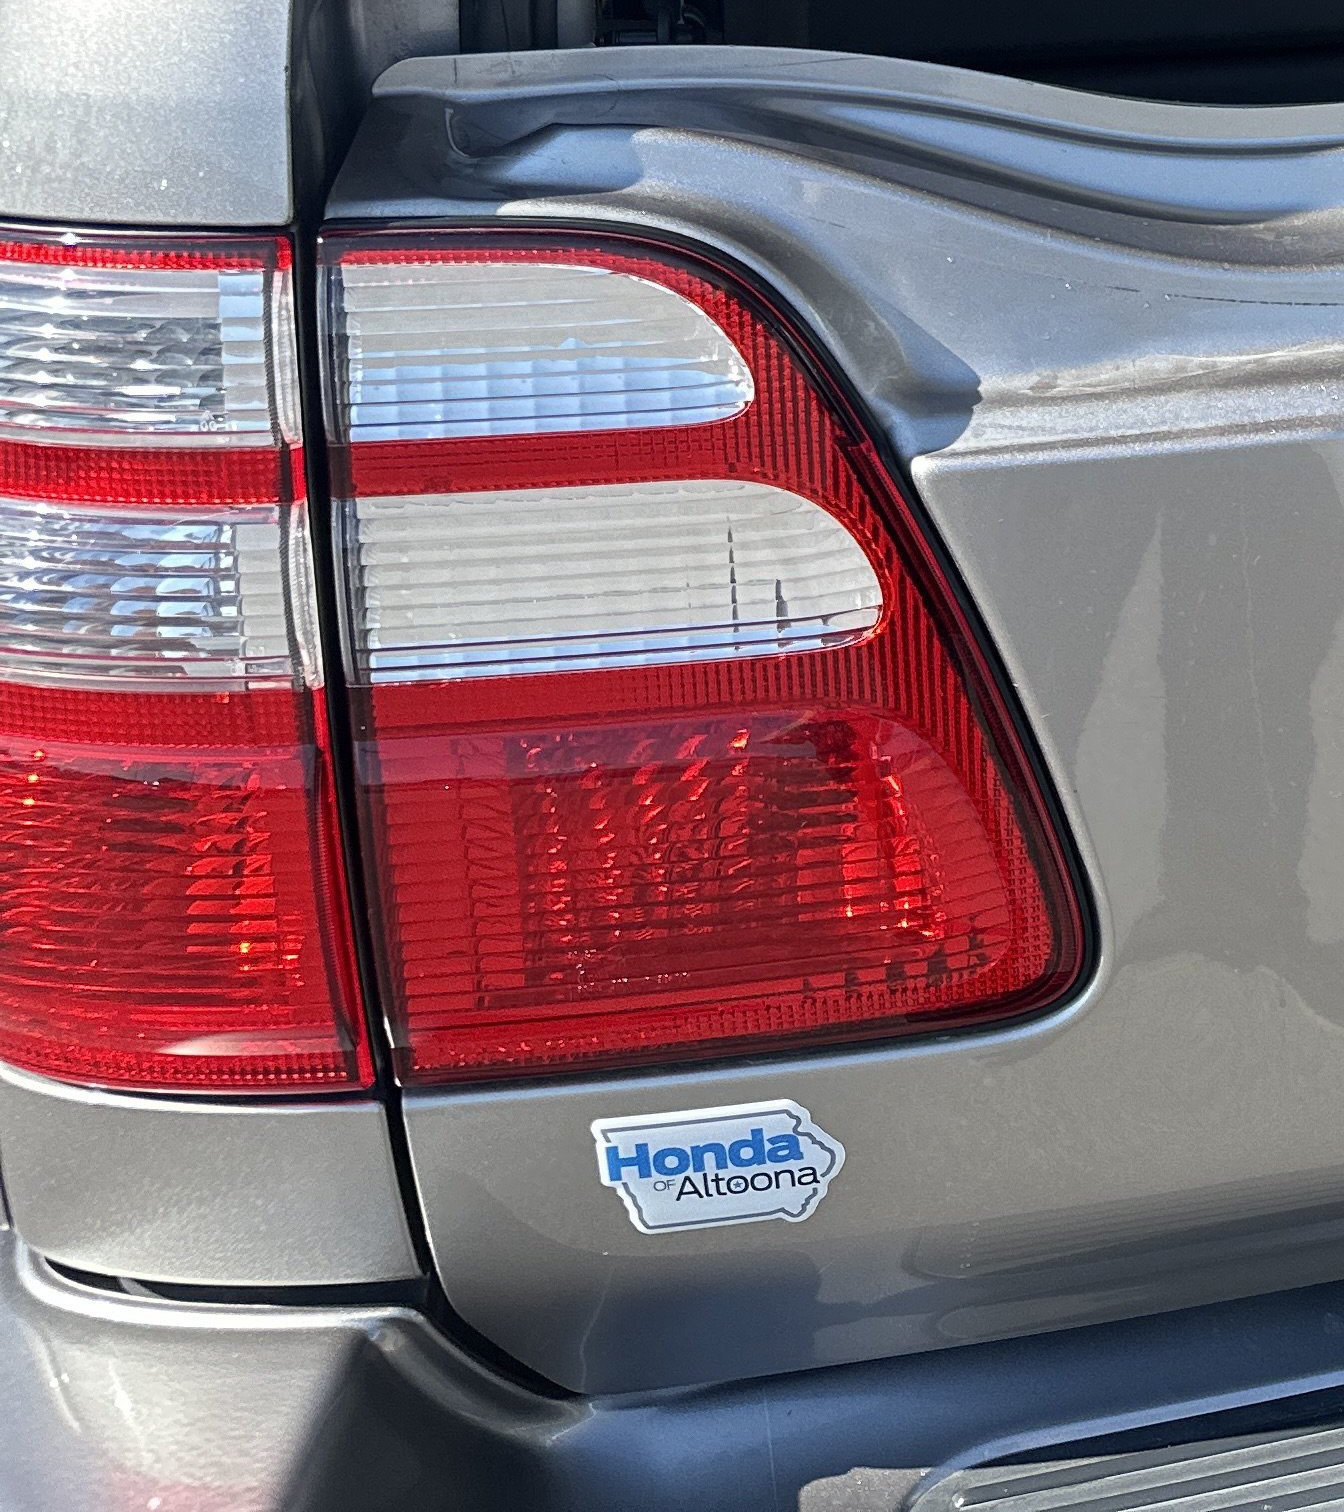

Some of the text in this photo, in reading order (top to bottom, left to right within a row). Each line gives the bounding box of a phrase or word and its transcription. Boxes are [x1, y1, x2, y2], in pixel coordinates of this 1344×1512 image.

[605, 1128, 804, 1182] Honda
[653, 1165, 821, 1201] OF Altoona
